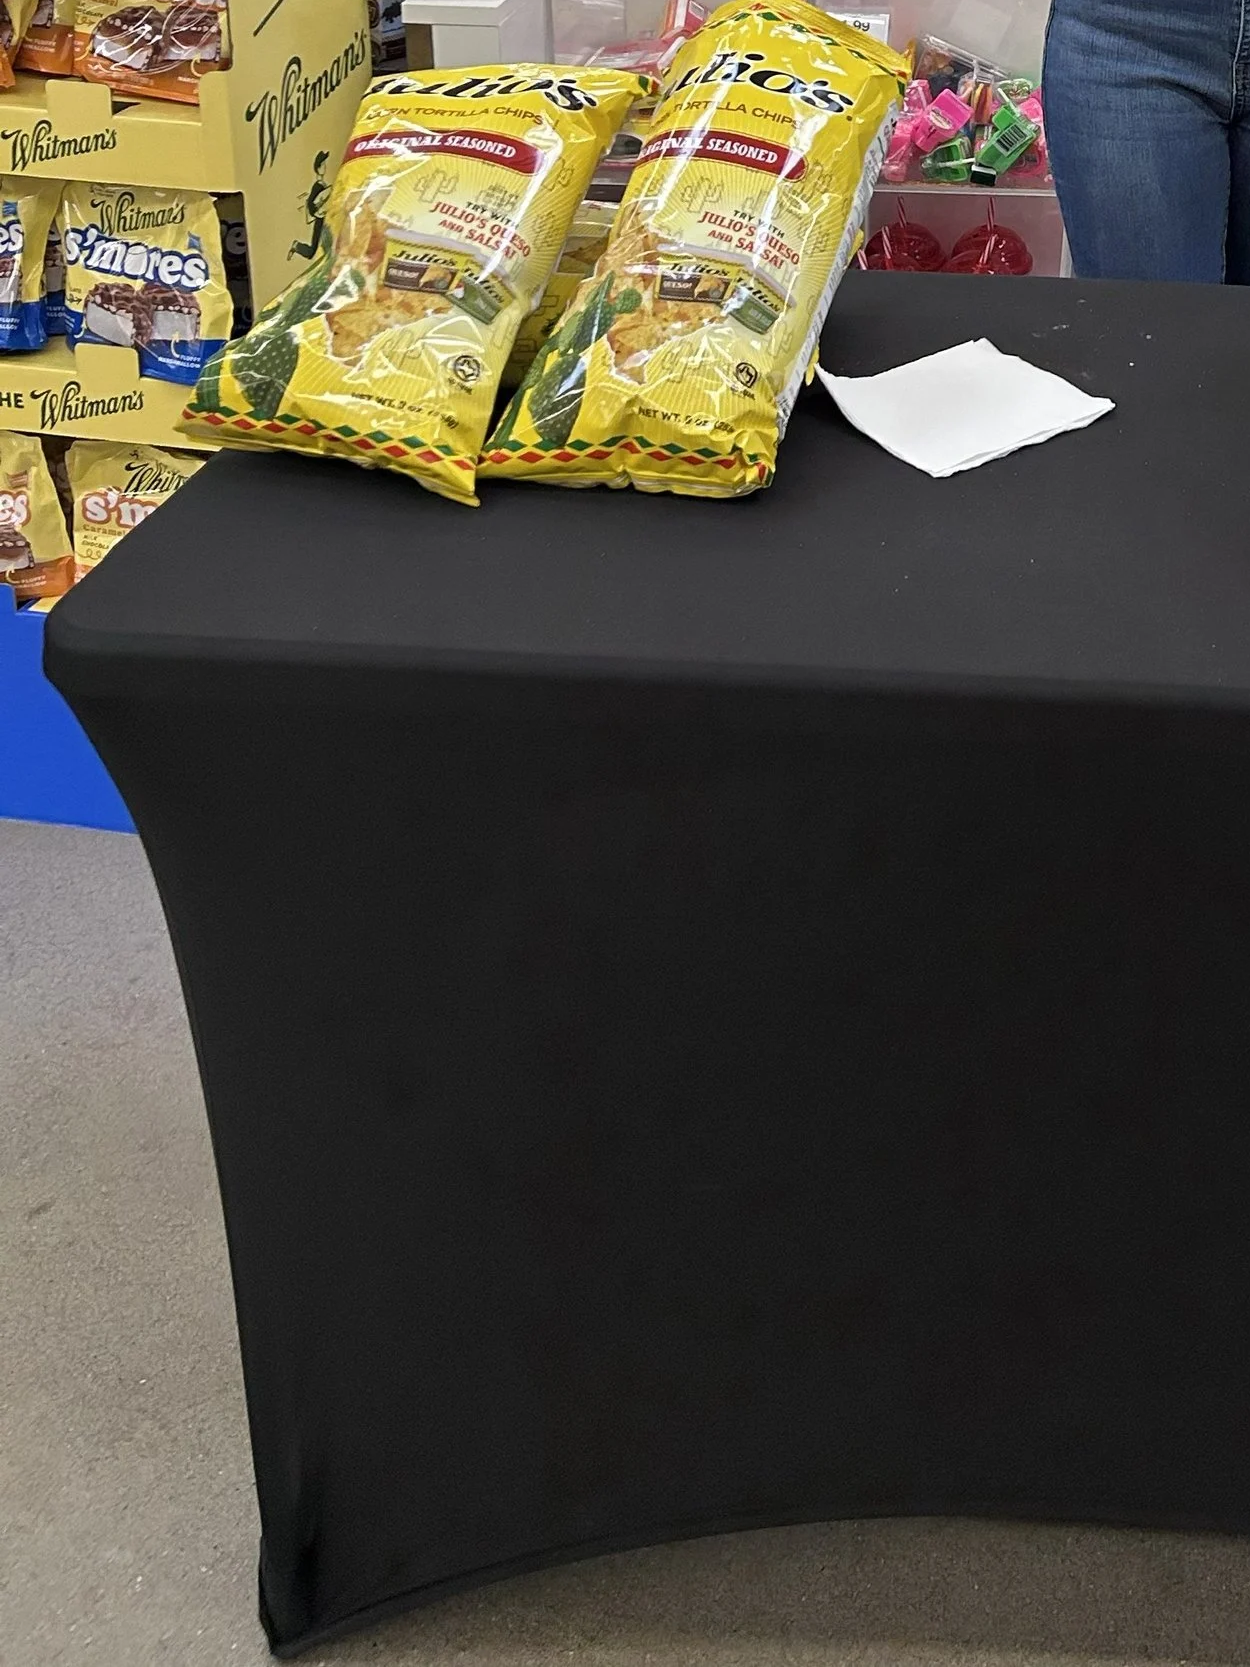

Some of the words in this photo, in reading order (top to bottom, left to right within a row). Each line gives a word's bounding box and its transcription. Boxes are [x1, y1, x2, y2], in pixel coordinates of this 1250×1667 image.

[666, 51, 855, 114] ulio's
[245, 27, 367, 175] Whitman's
[415, 107, 490, 118] TORTILLA
[493, 106, 543, 125] CHIPS
[673, 100, 747, 115] TORTLLA
[2, 119, 117, 172] Whitman's
[446, 134, 517, 158] SEASONED
[706, 137, 778, 164] SEASONED
[429, 201, 488, 230] JULIO'S
[465, 201, 488, 216] TRY
[733, 209, 756, 223] TRY
[698, 210, 756, 239] JULIO'S
[65, 226, 208, 290] s'mores
[707, 229, 735, 244] AND
[734, 237, 785, 271] SASA!
[0, 391, 25, 409] HE
[30, 380, 145, 431] Whitman's
